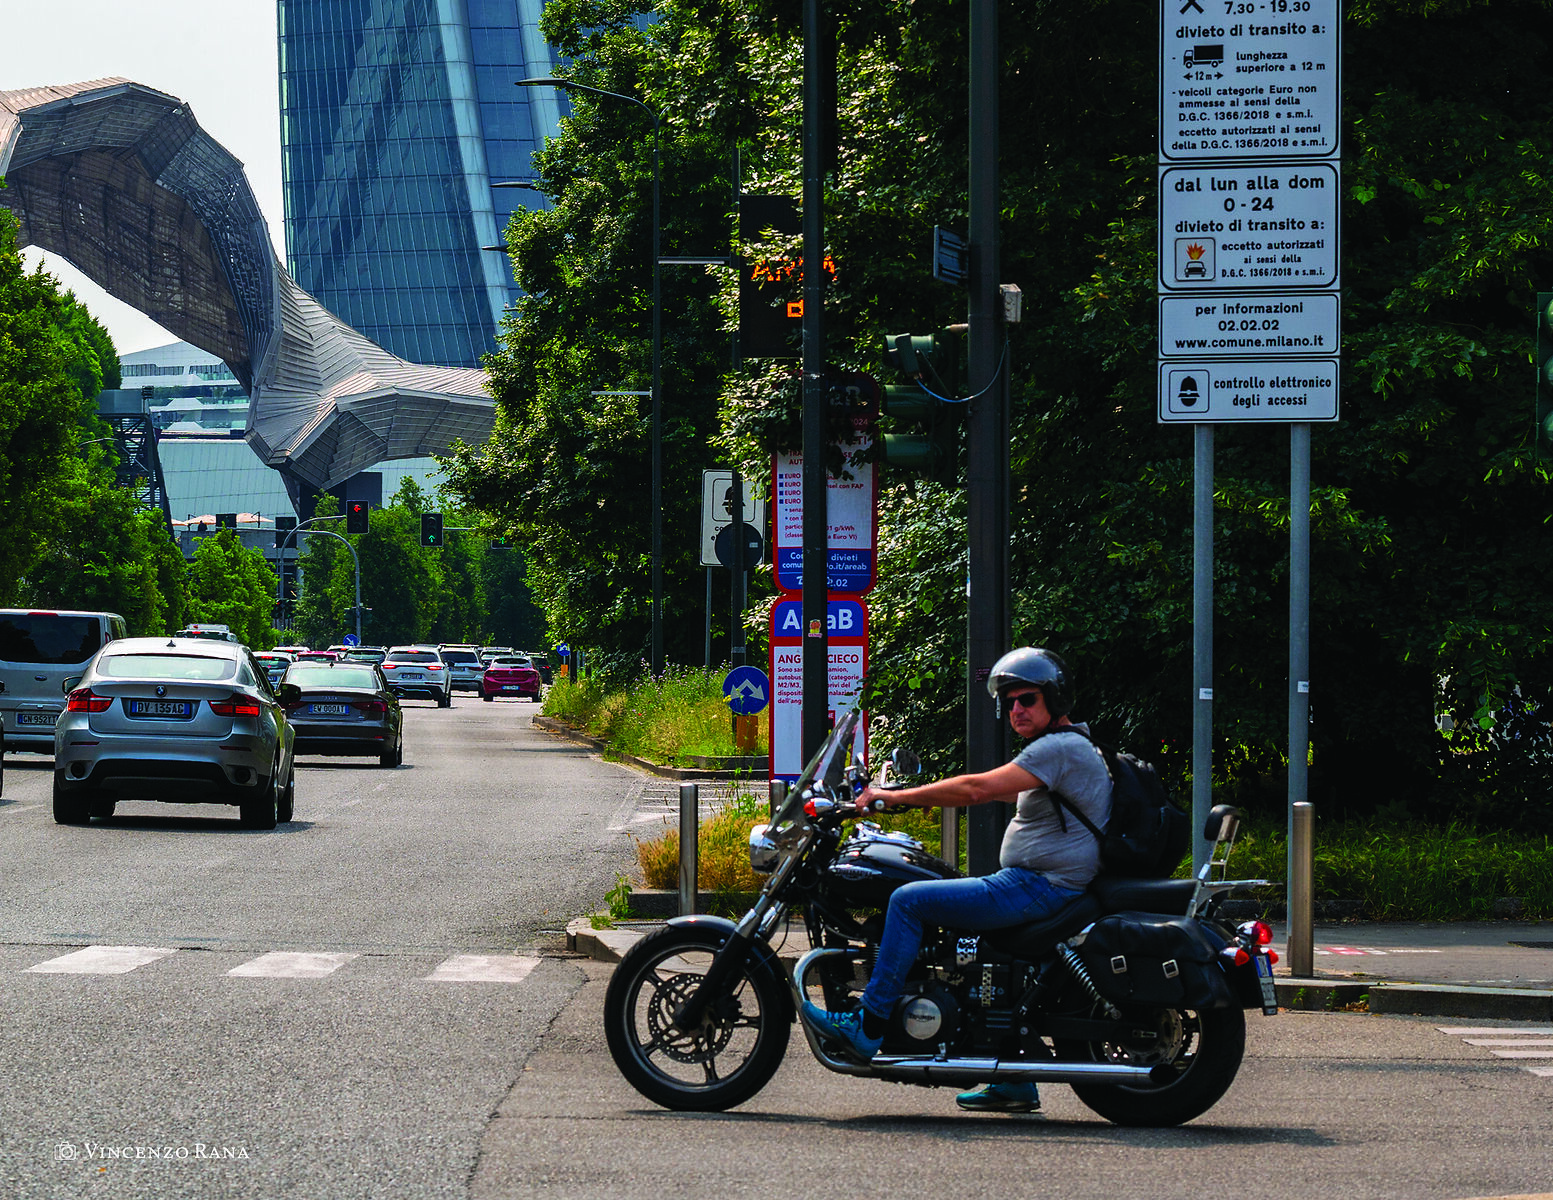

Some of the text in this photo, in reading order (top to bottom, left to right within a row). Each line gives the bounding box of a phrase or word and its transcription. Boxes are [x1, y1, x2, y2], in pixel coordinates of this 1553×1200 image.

[1224, 1, 1254, 14] 7.30
[1270, 0, 1310, 13] 19.30
[1176, 22, 1326, 38] divieto di transito a:
[1236, 51, 1287, 62] lunghezza
[1236, 64, 1285, 74] superiore
[1302, 62, 1313, 70] 12
[1195, 72, 1203, 80] 12
[1179, 87, 1211, 96] veicoli
[1216, 86, 1264, 97] categorie
[1269, 85, 1293, 94] Euro
[1179, 97, 1300, 108] ammesse ai sensi della
[1179, 113, 1210, 121] D.G.C.
[1214, 110, 1269, 120] 1366/2018
[1287, 109, 1313, 118] s.m.i.
[1179, 124, 1321, 137] eccetto autorizzati ai sensi
[1172, 141, 1196, 150] della
[1201, 140, 1232, 149] D.G.C.
[1235, 138, 1288, 148] 1366/2018
[1301, 137, 1327, 146] s.m.i.
[1175, 175, 1324, 192] dal lun alla dom
[1224, 198, 1235, 212] 0
[1251, 197, 1274, 211] 24
[1175, 218, 1324, 232] divieto di transito a:
[1222, 240, 1324, 251] eccetto autorizzati
[1244, 255, 1301, 264] ai sensi della
[1222, 269, 1246, 278] D.G.C.
[1250, 268, 1291, 277] 1366/2018
[1302, 267, 1325, 276] s.m.i.
[1195, 302, 1303, 316] per informazioni
[1218, 320, 1279, 331] 02.02.02
[1175, 335, 1323, 348] www.comune.milano.it
[1214, 376, 1331, 389] controllo elettronico
[1232, 394, 1307, 408] degli accessi
[831, 553, 858, 561] divieti
[137, 702, 149, 712] DV
